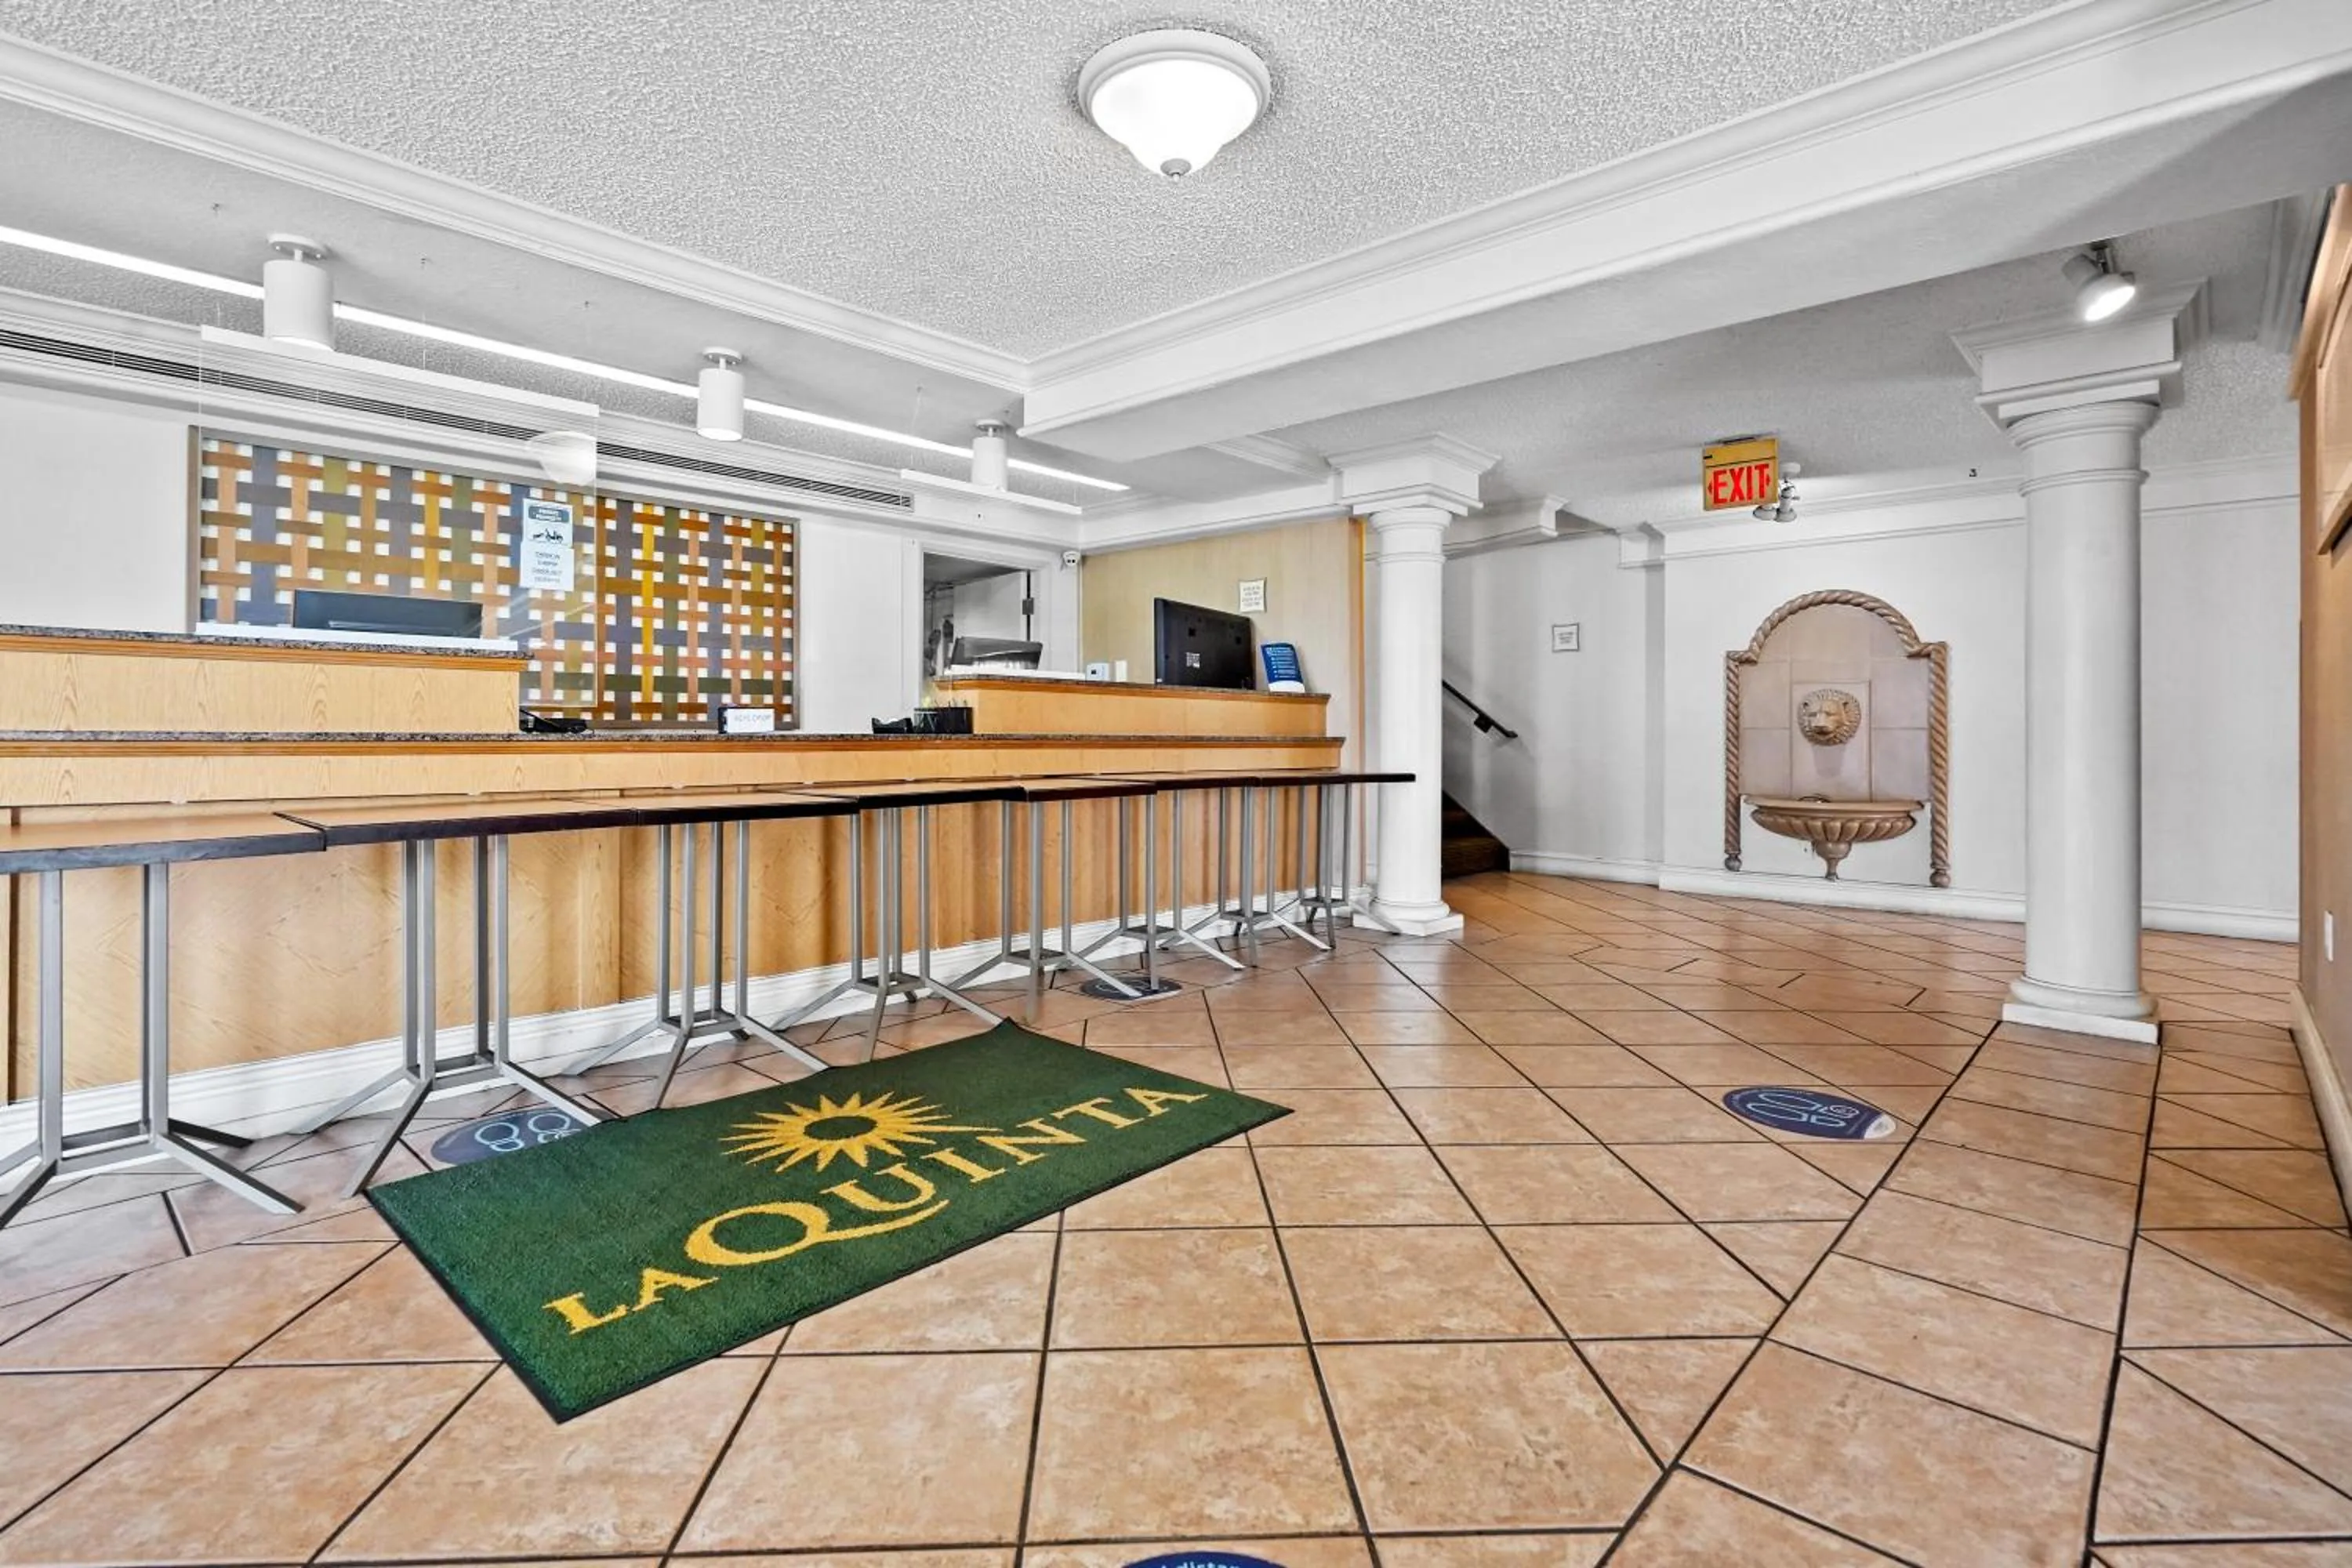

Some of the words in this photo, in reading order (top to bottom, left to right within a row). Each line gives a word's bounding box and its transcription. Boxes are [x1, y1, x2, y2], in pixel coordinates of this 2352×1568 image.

[1713, 463, 1769, 504] EXIT
[542, 1268, 720, 1334] LA
[684, 1087, 1208, 1265] QUINTA
